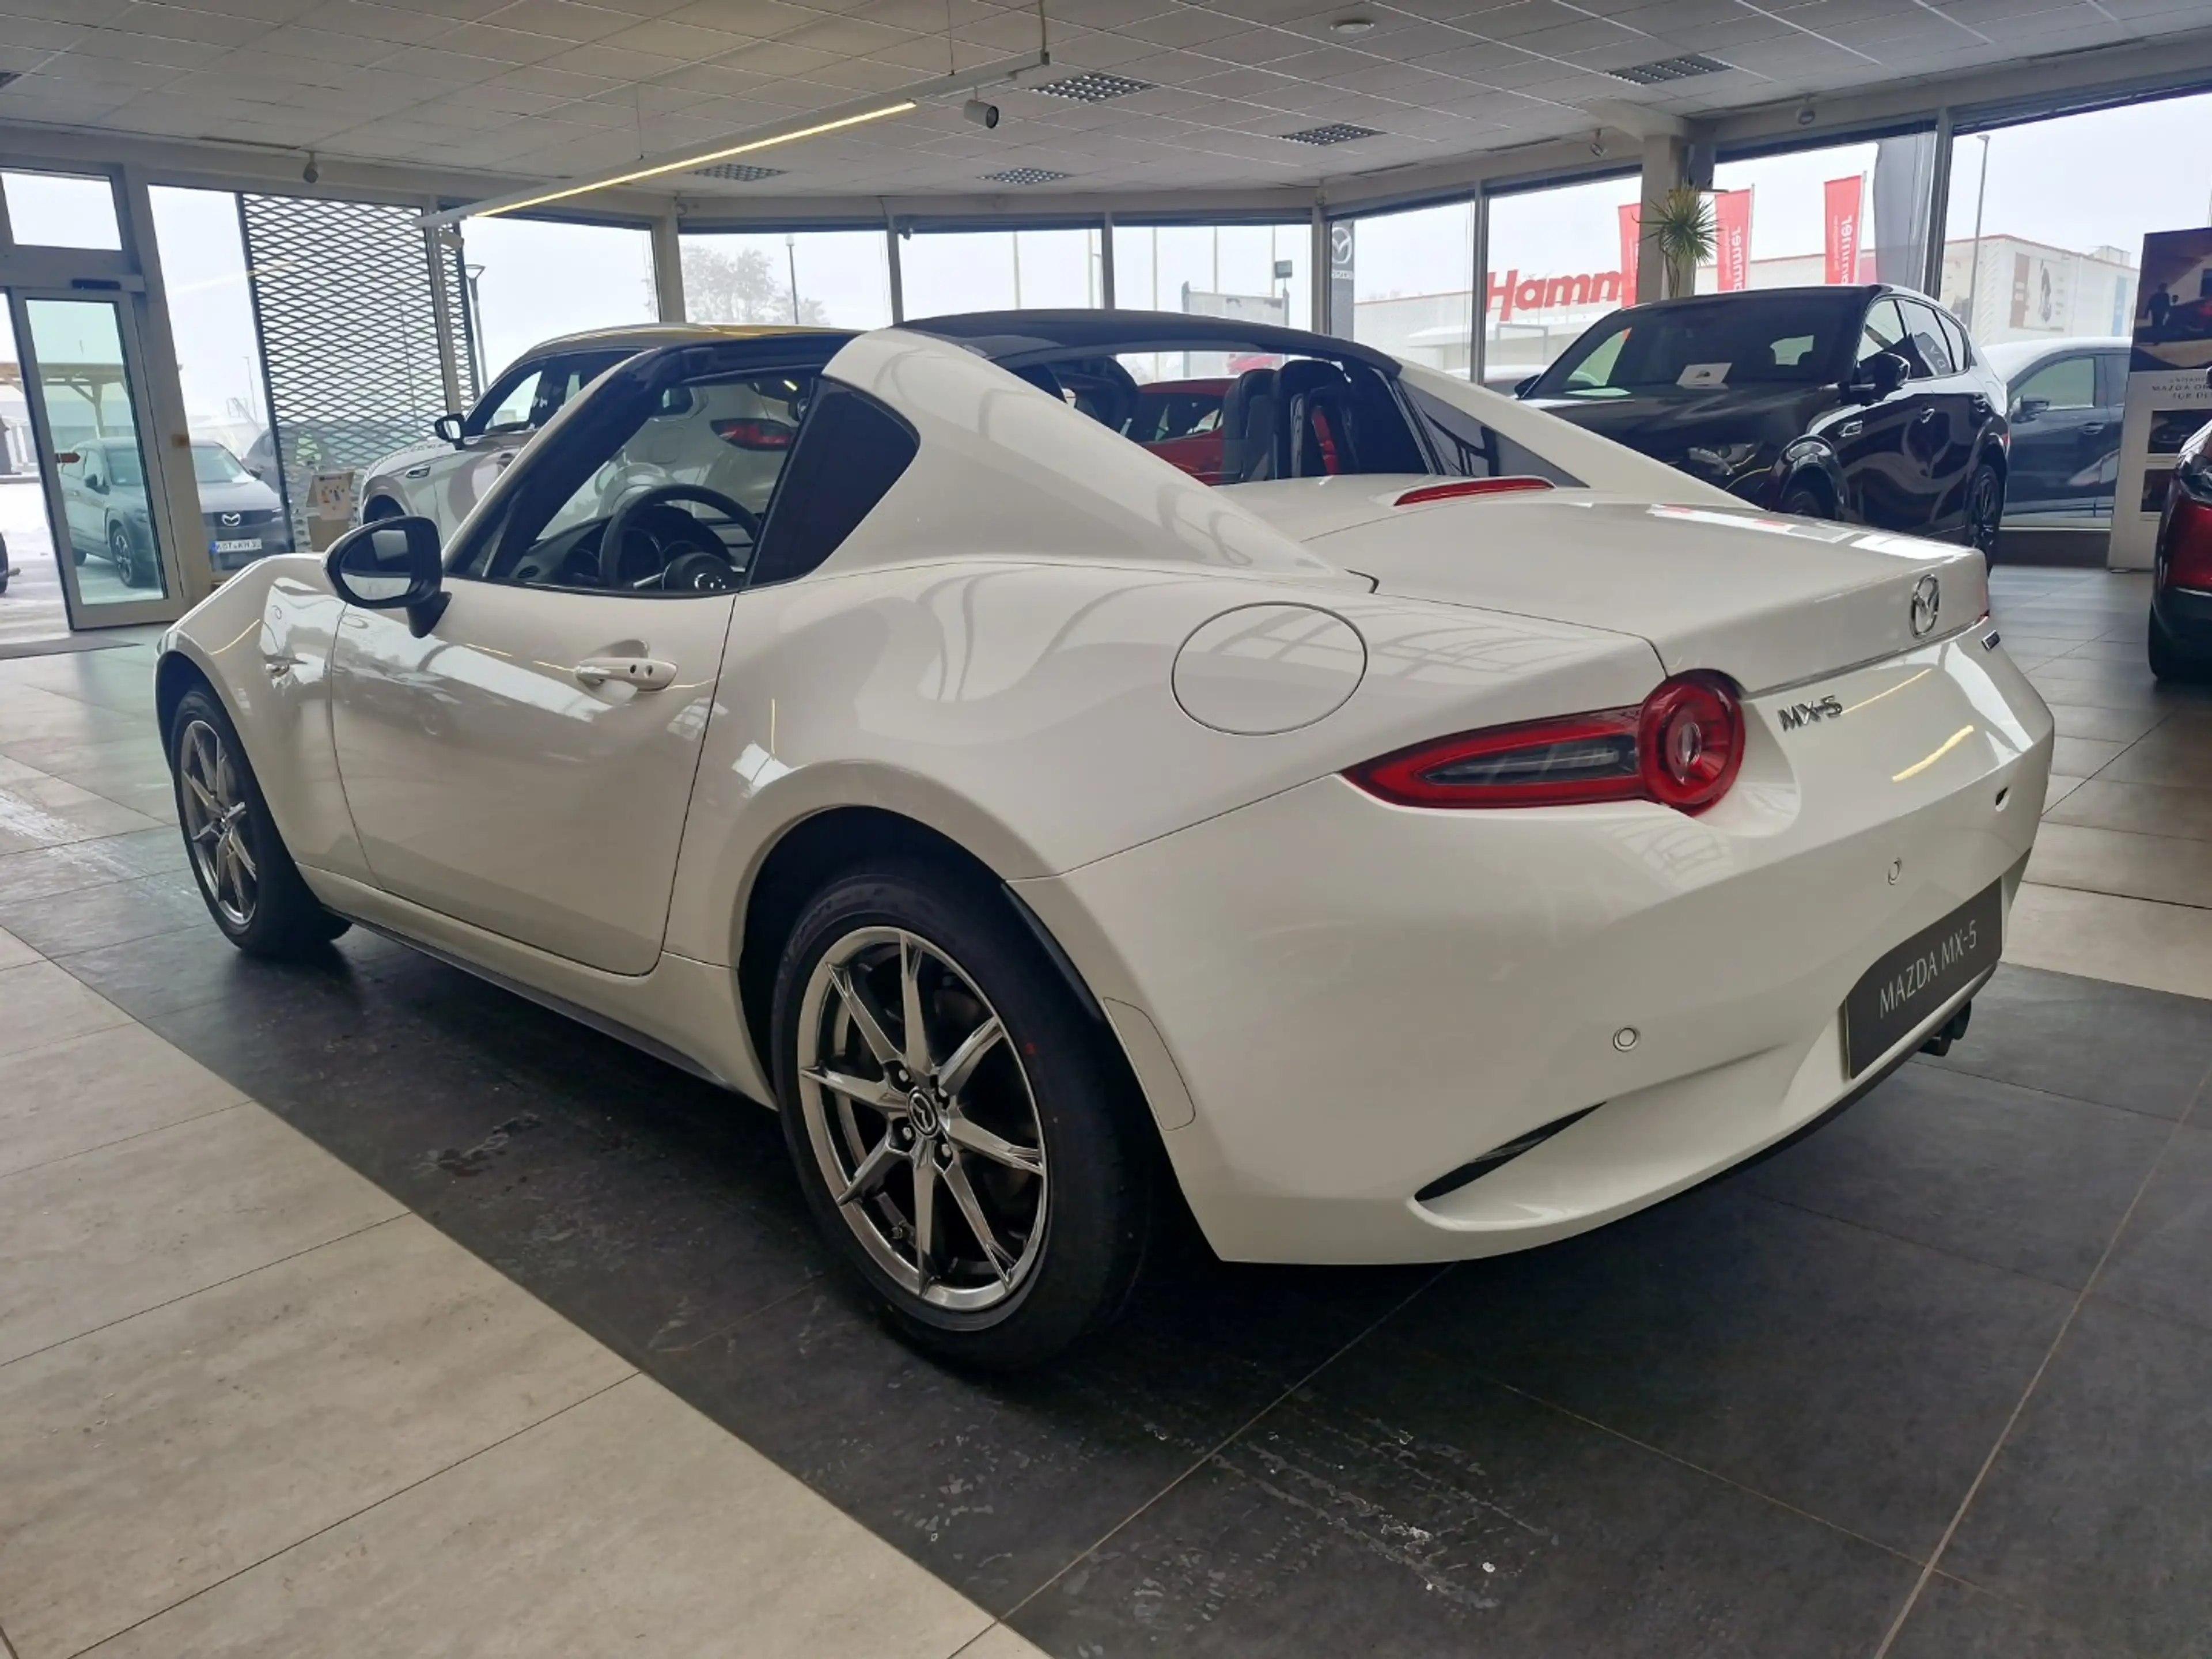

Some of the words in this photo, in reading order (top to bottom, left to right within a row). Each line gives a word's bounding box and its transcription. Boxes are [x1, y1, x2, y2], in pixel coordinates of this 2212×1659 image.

[1778, 695, 1843, 733] MX-5
[1879, 951, 1938, 1019] MAZDA
[1941, 919, 1977, 971] MX-5
